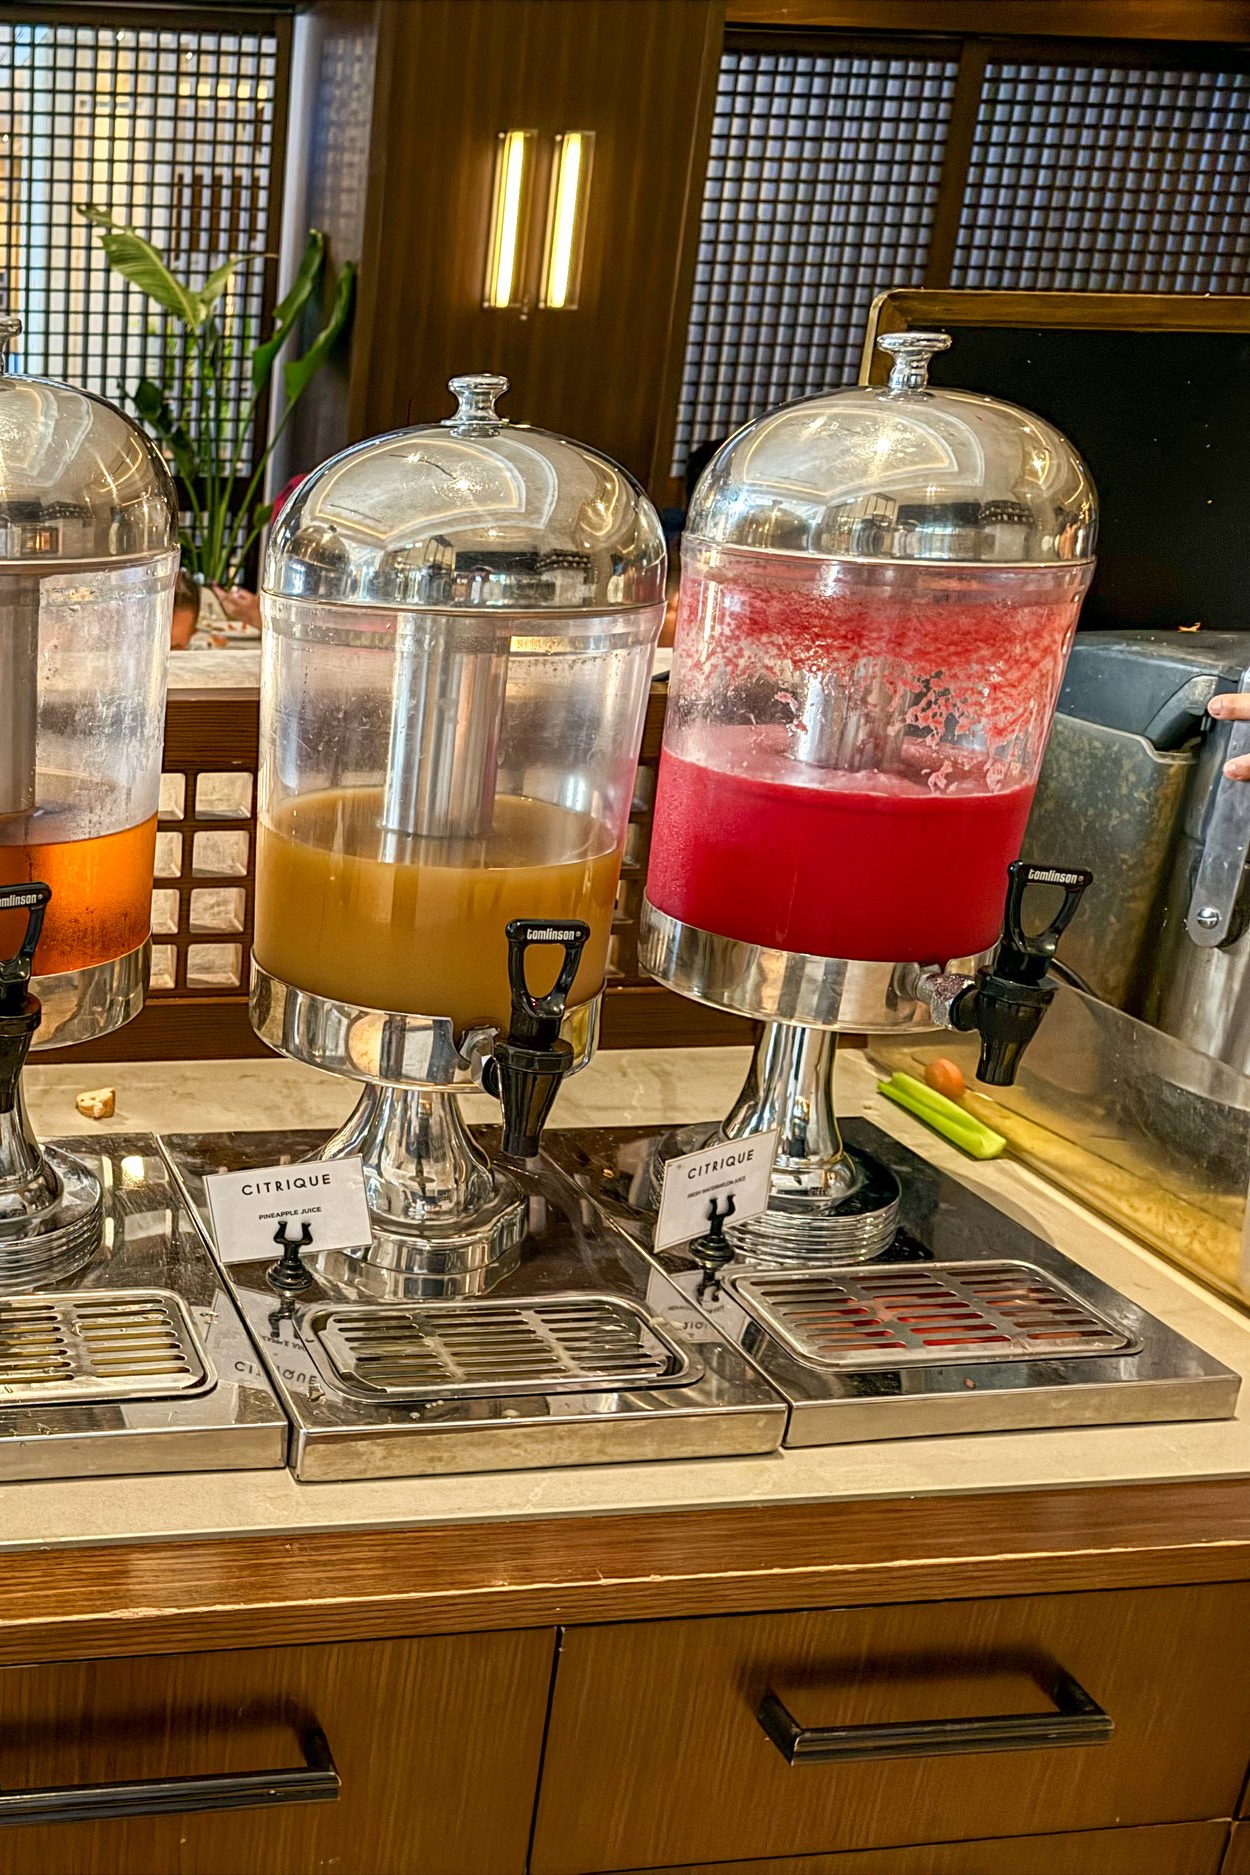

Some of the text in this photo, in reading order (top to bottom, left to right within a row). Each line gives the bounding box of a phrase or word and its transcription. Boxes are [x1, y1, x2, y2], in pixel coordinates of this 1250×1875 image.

[1028, 868, 1077, 884] tomlinson
[527, 928, 575, 940] tomlinson
[687, 1149, 754, 1180] CITRIQUE
[241, 1173, 332, 1196] CITRIQUE
[258, 1206, 322, 1221] PINEAPPLE JUICE
